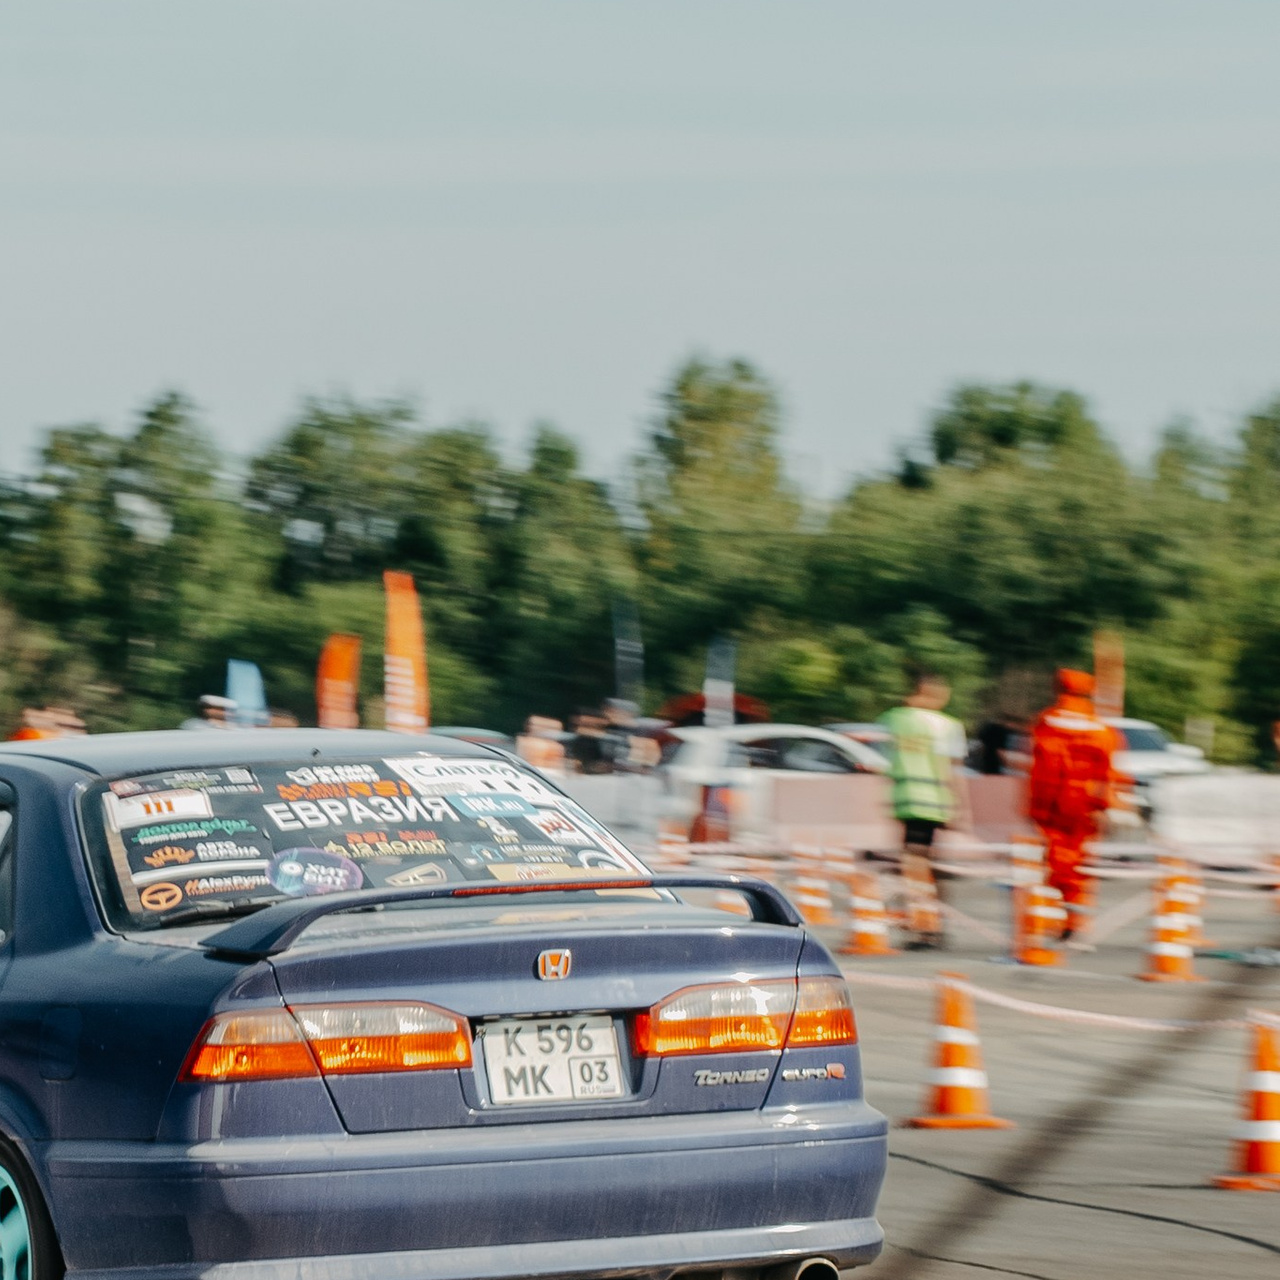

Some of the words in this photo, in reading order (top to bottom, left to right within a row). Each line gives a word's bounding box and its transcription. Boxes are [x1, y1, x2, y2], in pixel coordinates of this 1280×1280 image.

[263, 795, 460, 832] ЕВРАЗИЯ
[537, 1022, 593, 1054] 596
[580, 1061, 609, 1083] 03
[694, 1068, 769, 1086] TORNEO
[581, 1086, 601, 1094] RUS
